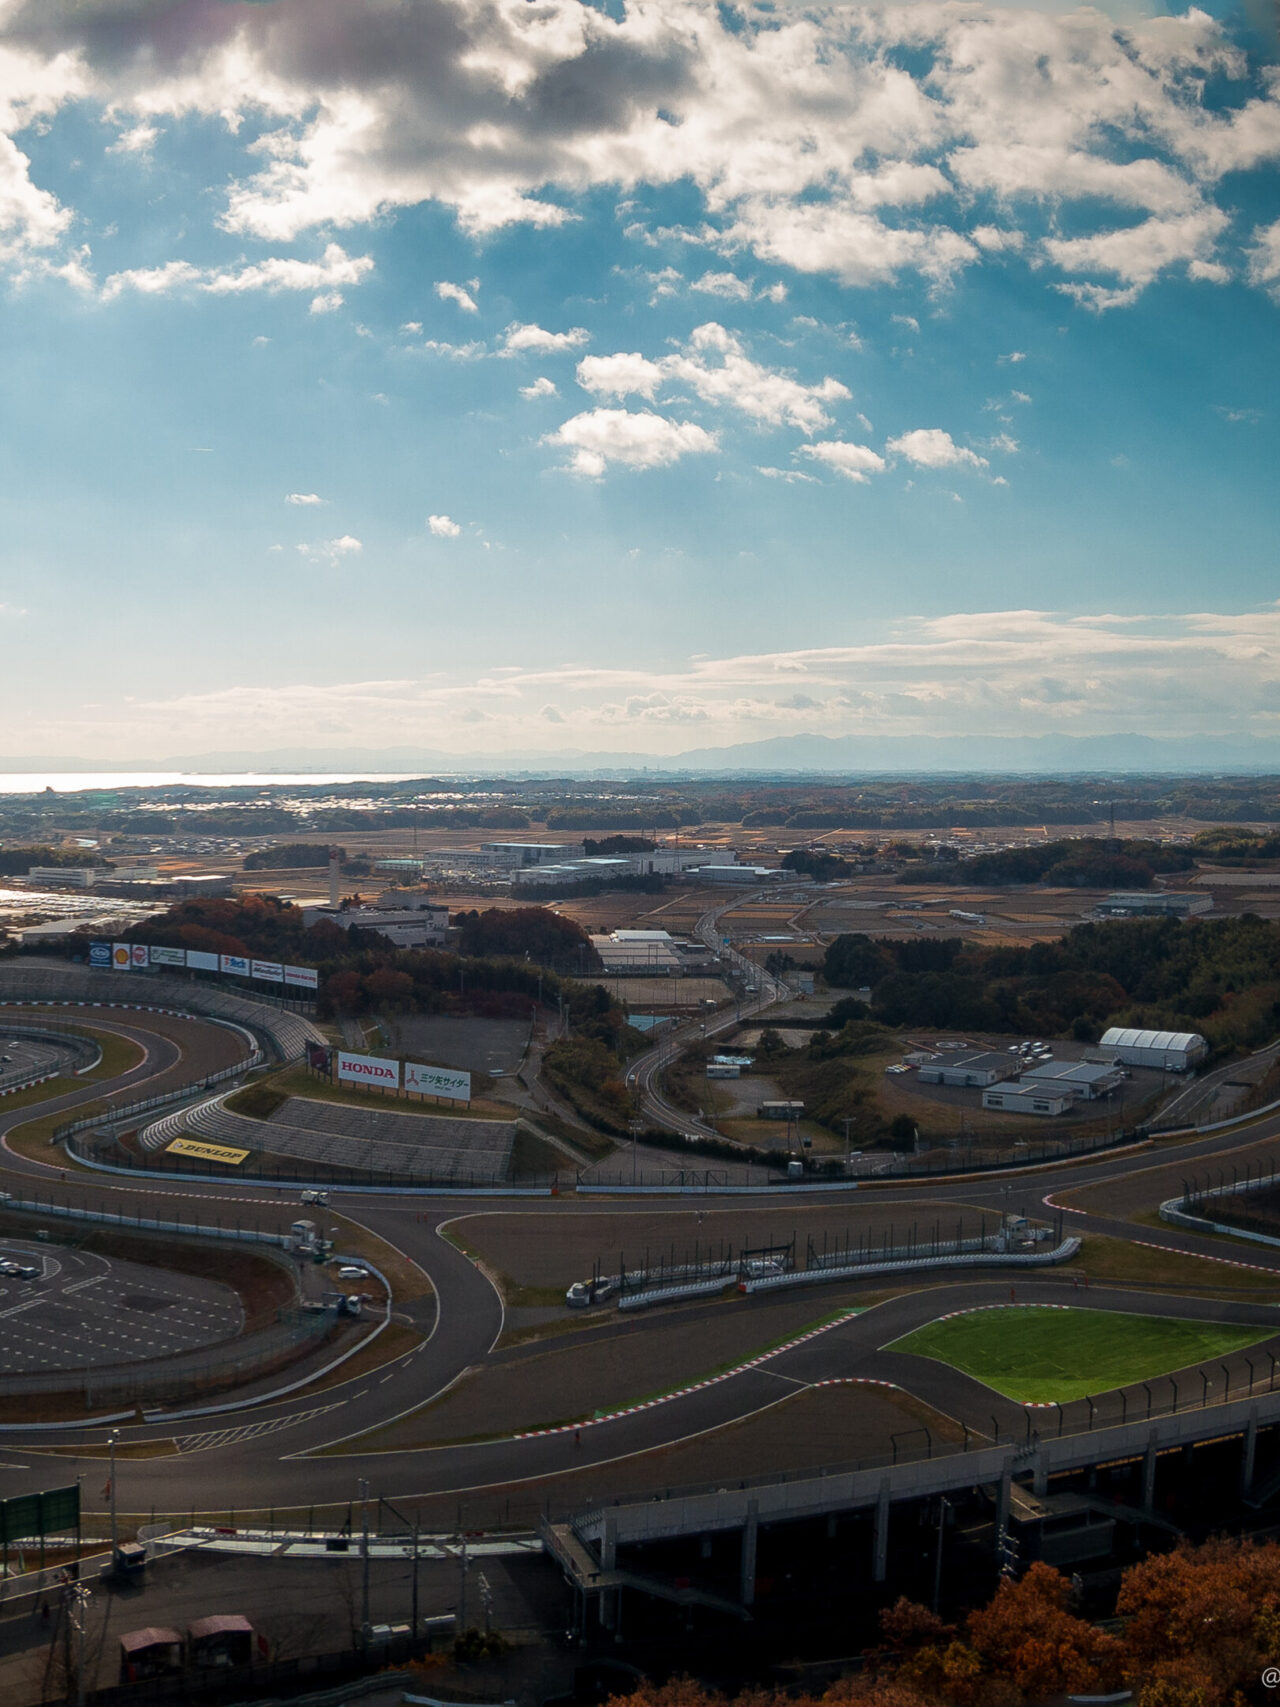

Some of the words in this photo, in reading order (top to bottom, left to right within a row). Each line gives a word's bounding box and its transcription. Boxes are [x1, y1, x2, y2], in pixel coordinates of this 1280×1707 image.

[341, 1061, 395, 1079] HONDA
[420, 1073, 469, 1088] 三ツ矢サイダー
[183, 1144, 242, 1158] DUNLOP
